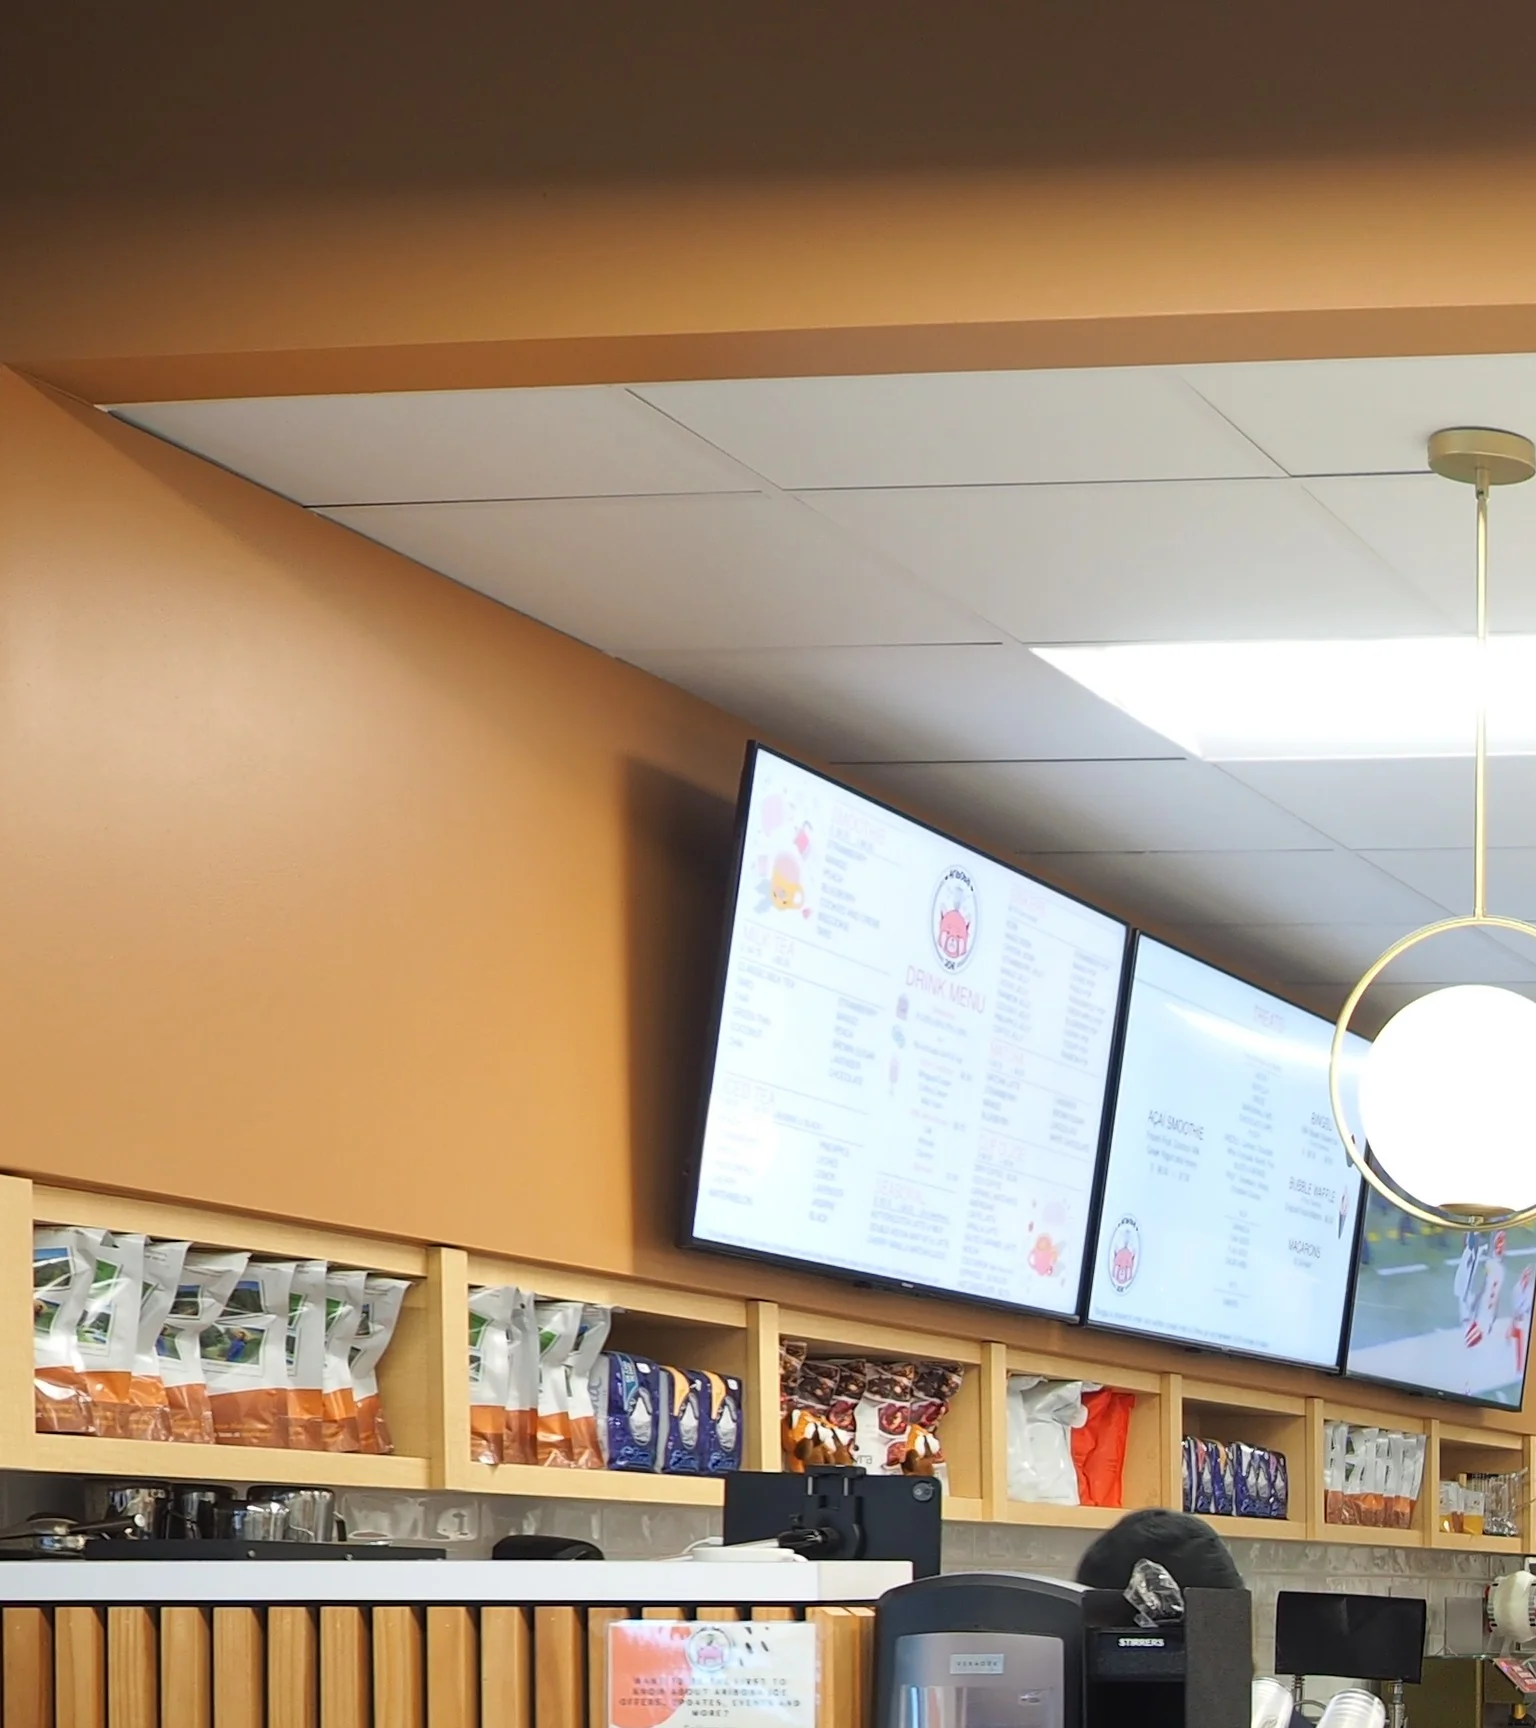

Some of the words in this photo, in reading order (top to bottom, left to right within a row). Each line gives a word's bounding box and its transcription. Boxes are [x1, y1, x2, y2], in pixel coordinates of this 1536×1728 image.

[905, 964, 946, 1000] DRINK
[949, 982, 986, 1015] MENU
[1118, 1637, 1165, 1647] STIRRERS
[773, 1677, 787, 1685] TO
[671, 1688, 708, 1696] ABOUT
[691, 1709, 730, 1717] MORE?
